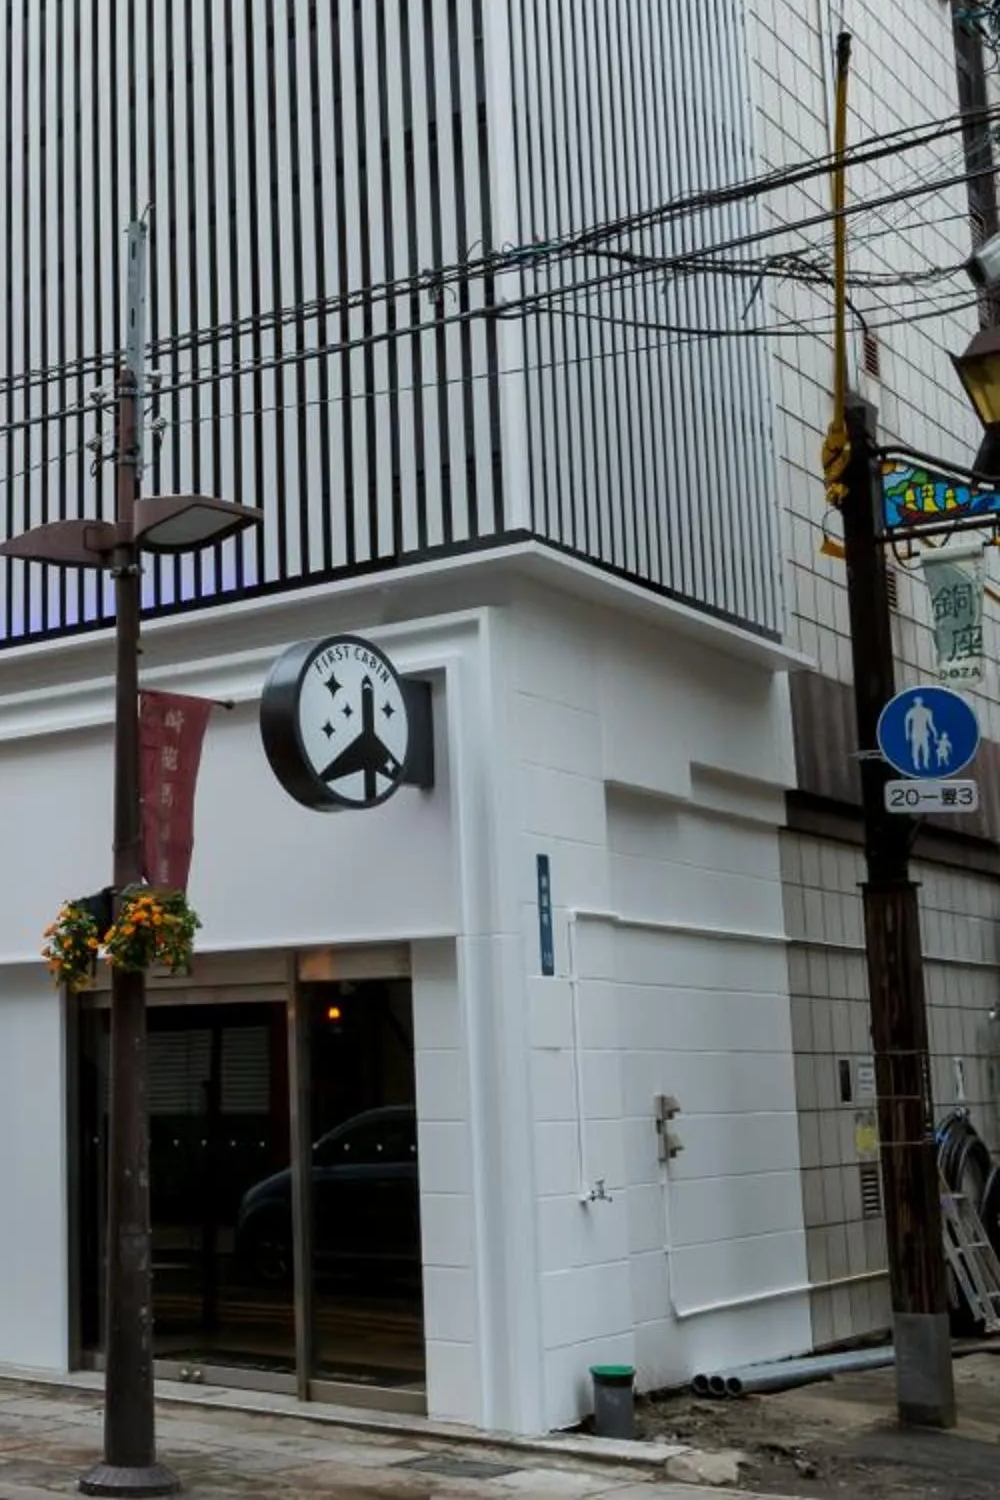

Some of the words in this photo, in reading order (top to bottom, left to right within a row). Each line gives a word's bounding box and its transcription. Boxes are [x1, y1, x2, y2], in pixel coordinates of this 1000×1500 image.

[932, 582, 983, 661] 銅座
[314, 645, 350, 675] FIRST
[354, 647, 391, 683] CABIN
